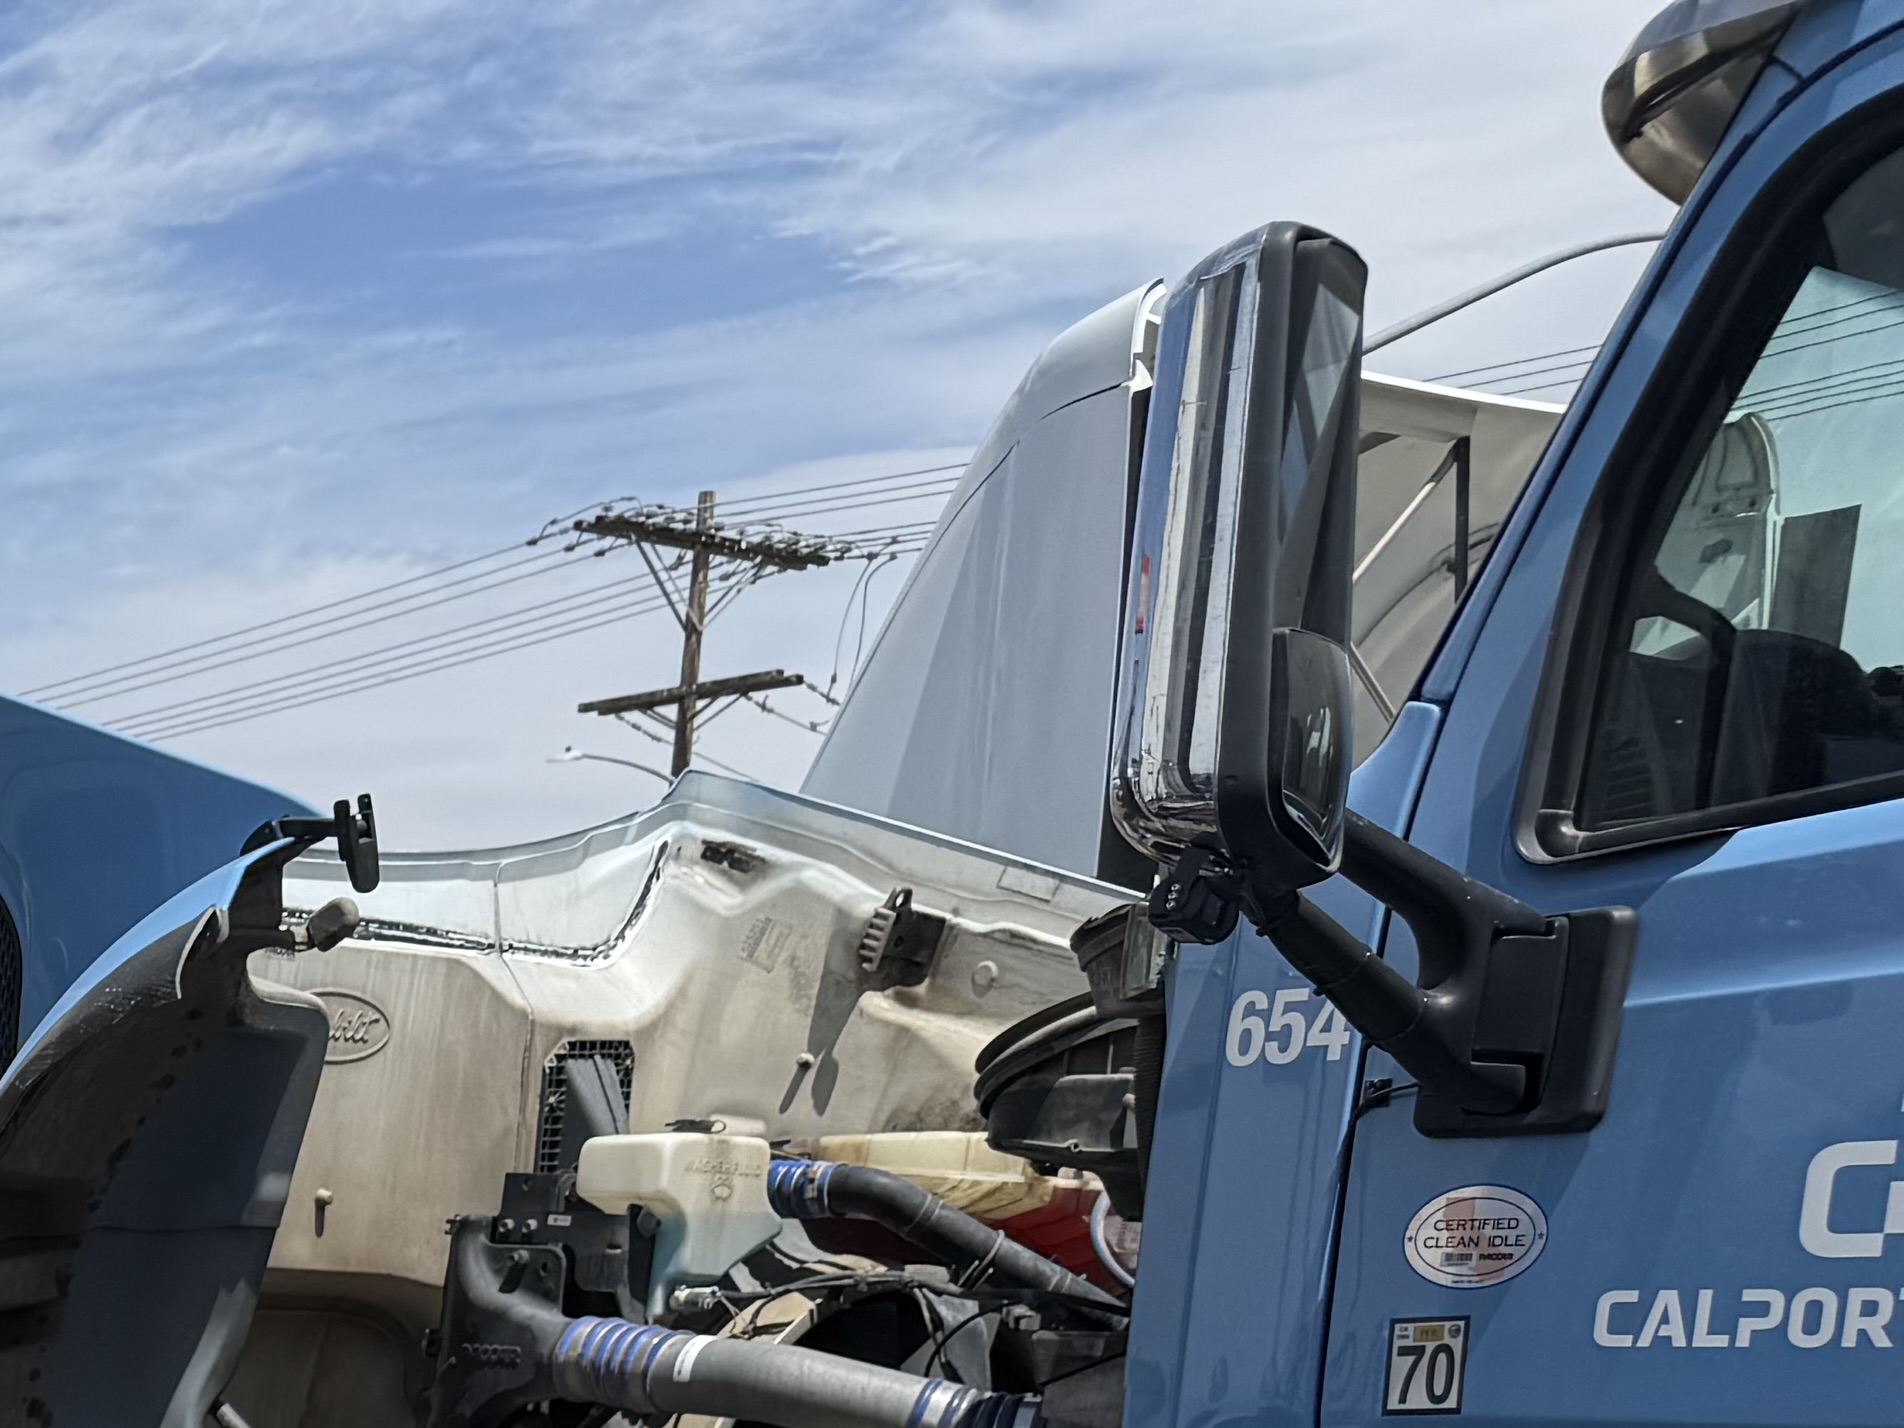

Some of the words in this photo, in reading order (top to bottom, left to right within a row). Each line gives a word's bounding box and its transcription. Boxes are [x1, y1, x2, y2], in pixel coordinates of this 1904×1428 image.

[1423, 1236, 1480, 1250] CLEAN
[1487, 1234, 1527, 1248] IDLE
[1433, 1217, 1520, 1232] CERTIFIED
[1592, 1286, 1904, 1349] CALPOR
[1397, 1343, 1456, 1405] 70
